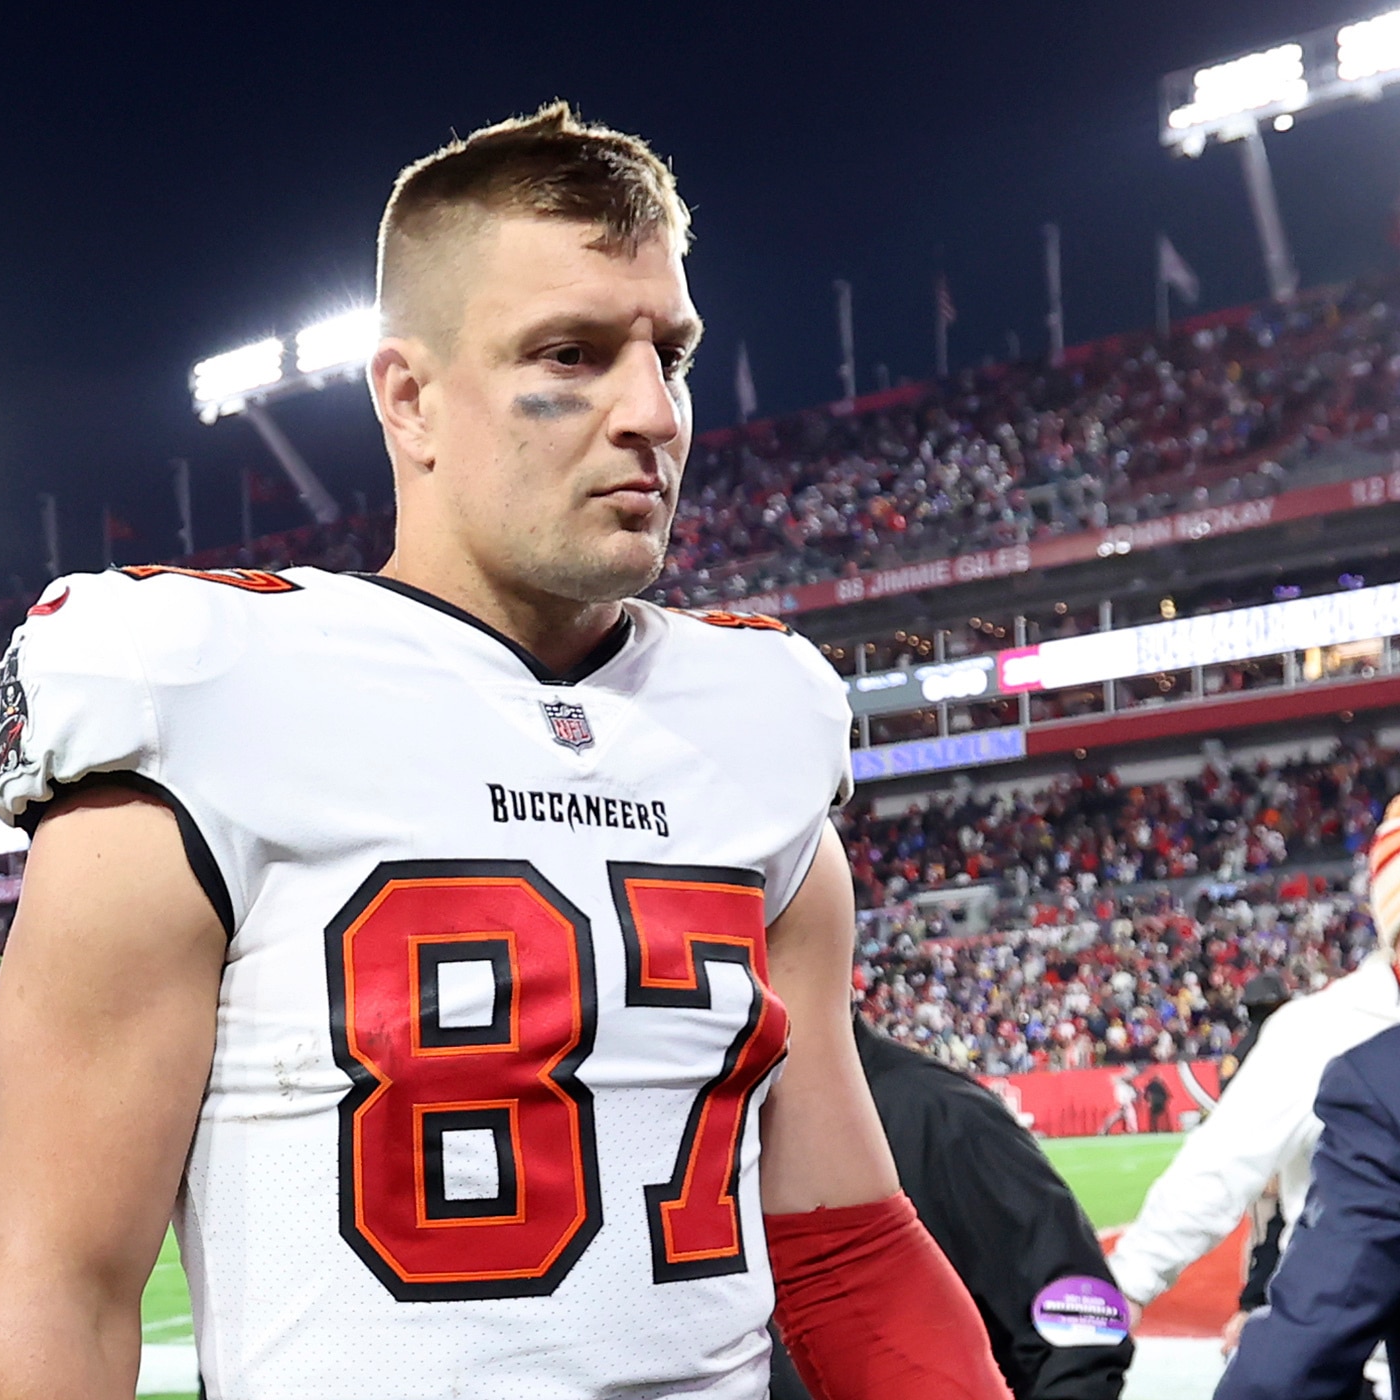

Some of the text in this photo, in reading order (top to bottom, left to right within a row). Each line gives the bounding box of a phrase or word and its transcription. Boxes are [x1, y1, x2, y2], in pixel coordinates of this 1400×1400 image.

[870, 557, 950, 598] JIMMIE
[954, 544, 1032, 582] GILES
[554, 719, 589, 742] NFL
[889, 728, 1023, 775] STADIUM
[486, 783, 670, 837] BUCCANEERS
[324, 858, 791, 1302] 87
